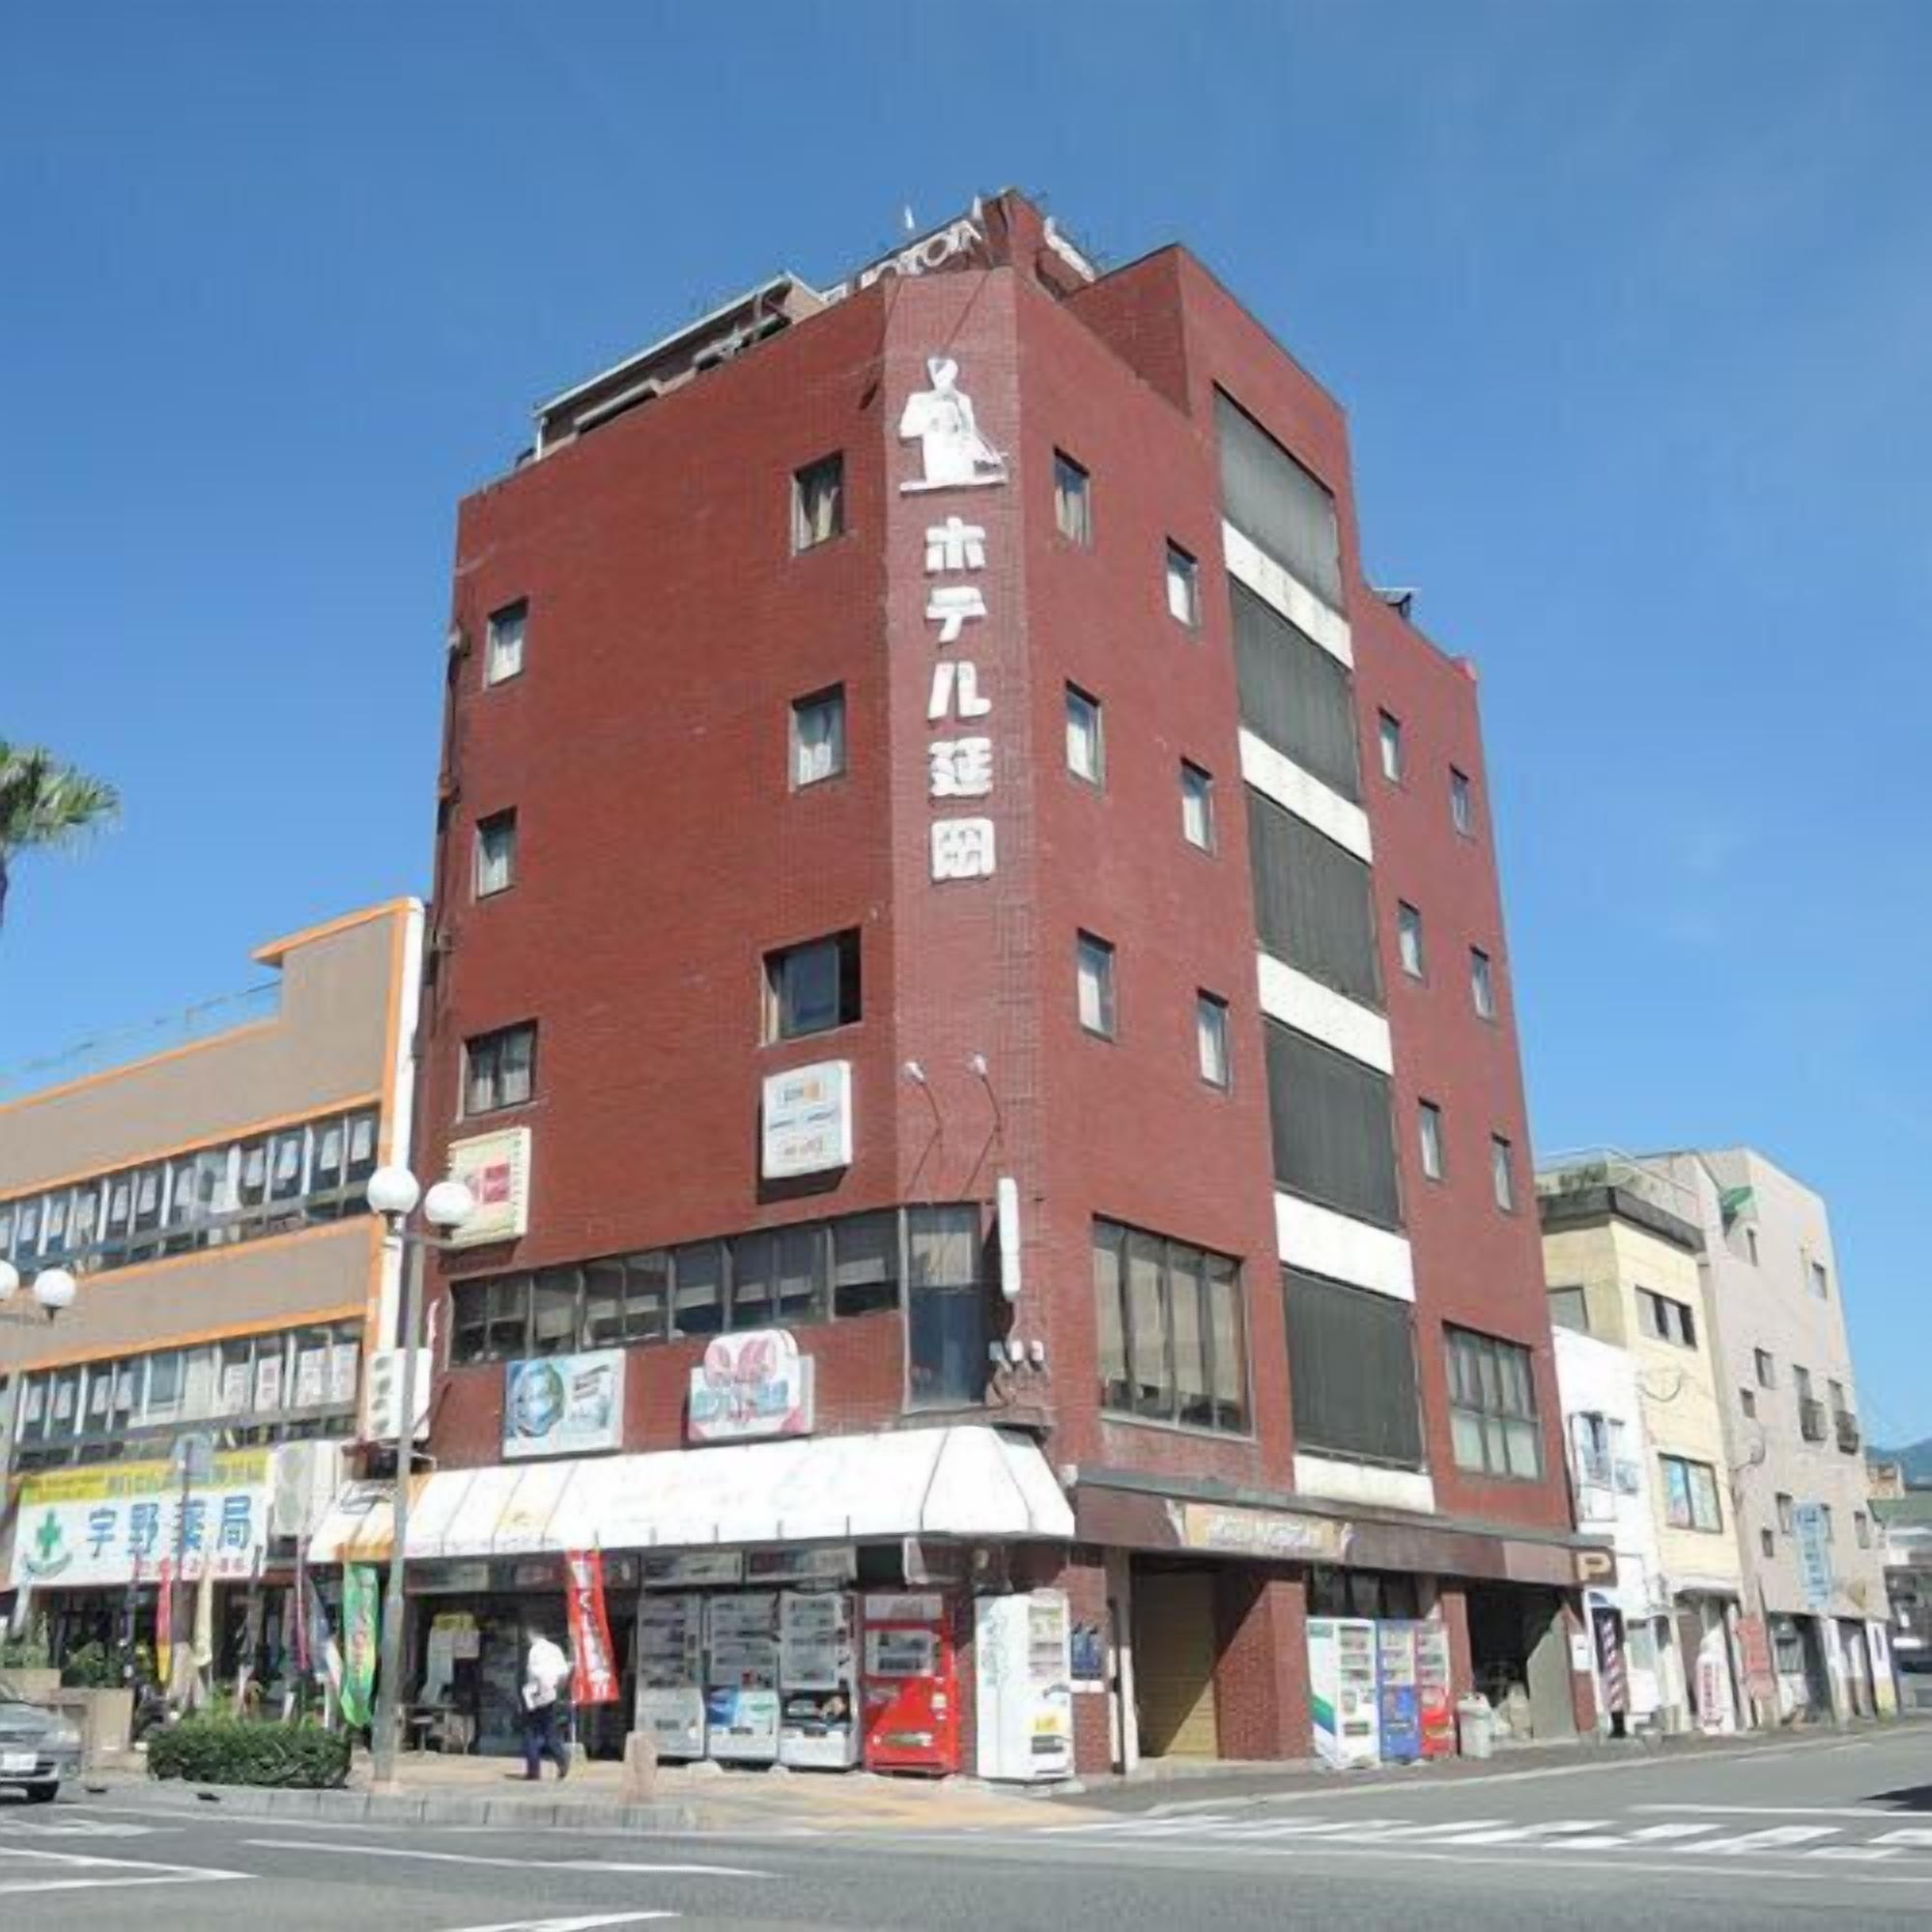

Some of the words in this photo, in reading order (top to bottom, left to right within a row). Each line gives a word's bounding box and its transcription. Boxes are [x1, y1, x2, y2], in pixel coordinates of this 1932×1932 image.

[87, 1495, 252, 1557] 宇野薬局
[1577, 1551, 1611, 1581] P
